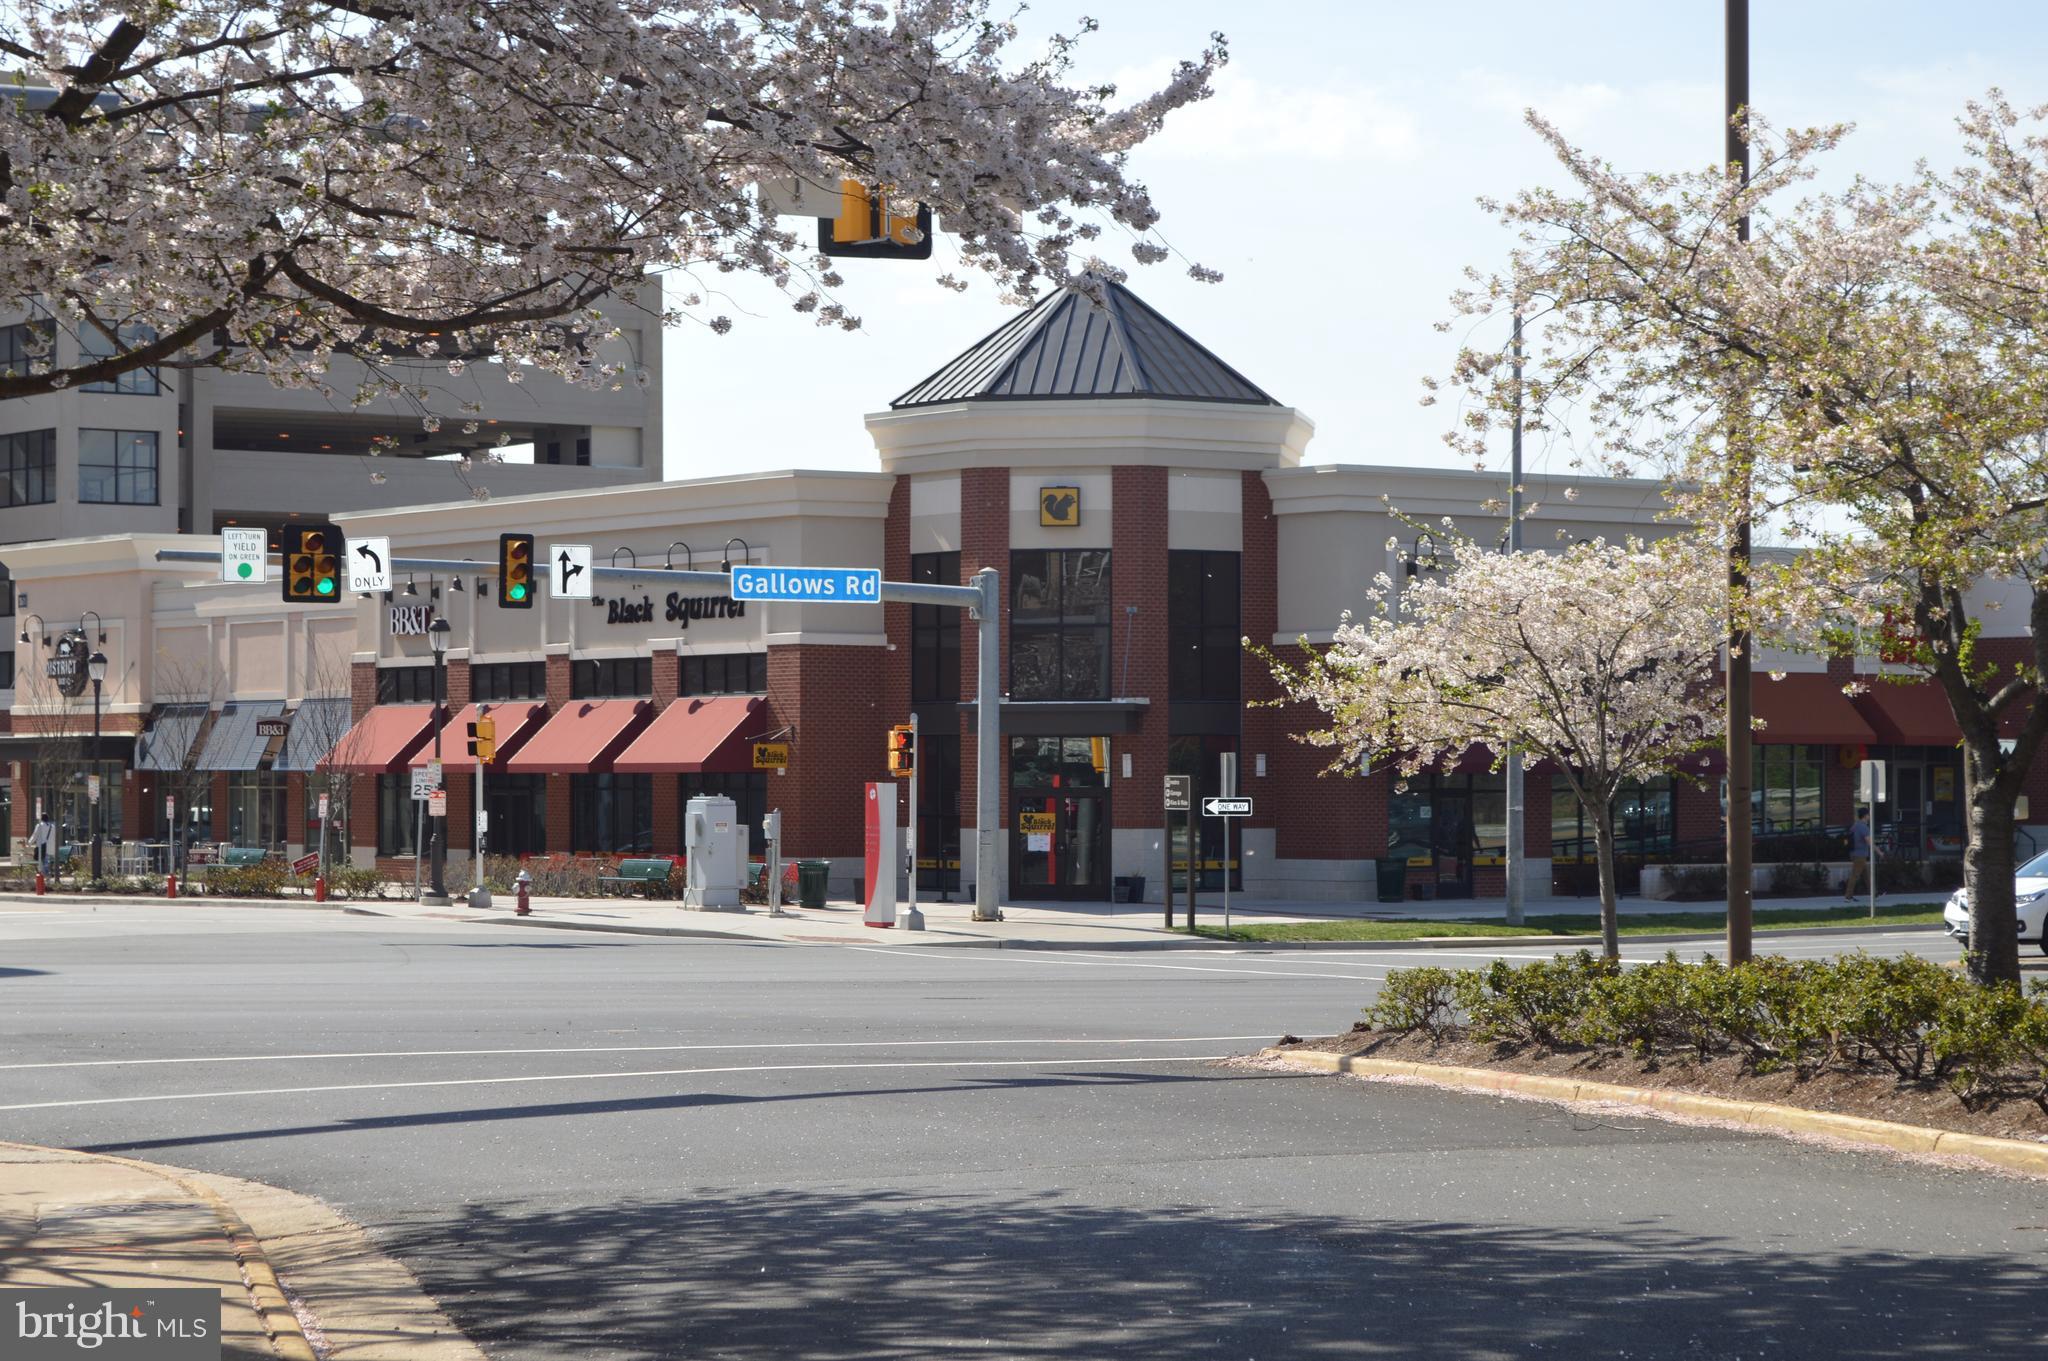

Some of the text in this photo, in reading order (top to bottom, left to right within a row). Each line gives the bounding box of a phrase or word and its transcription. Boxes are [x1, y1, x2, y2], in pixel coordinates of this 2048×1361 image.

[233, 542, 257, 552] YIELD
[354, 576, 385, 588] ONLY
[737, 573, 875, 595] Gallows Rd
[592, 592, 745, 629] The Black Squirrel
[390, 605, 430, 635] BB&T
[47, 659, 77, 676] DISTRICT
[259, 724, 287, 736] BB&T
[413, 784, 432, 796] 25
